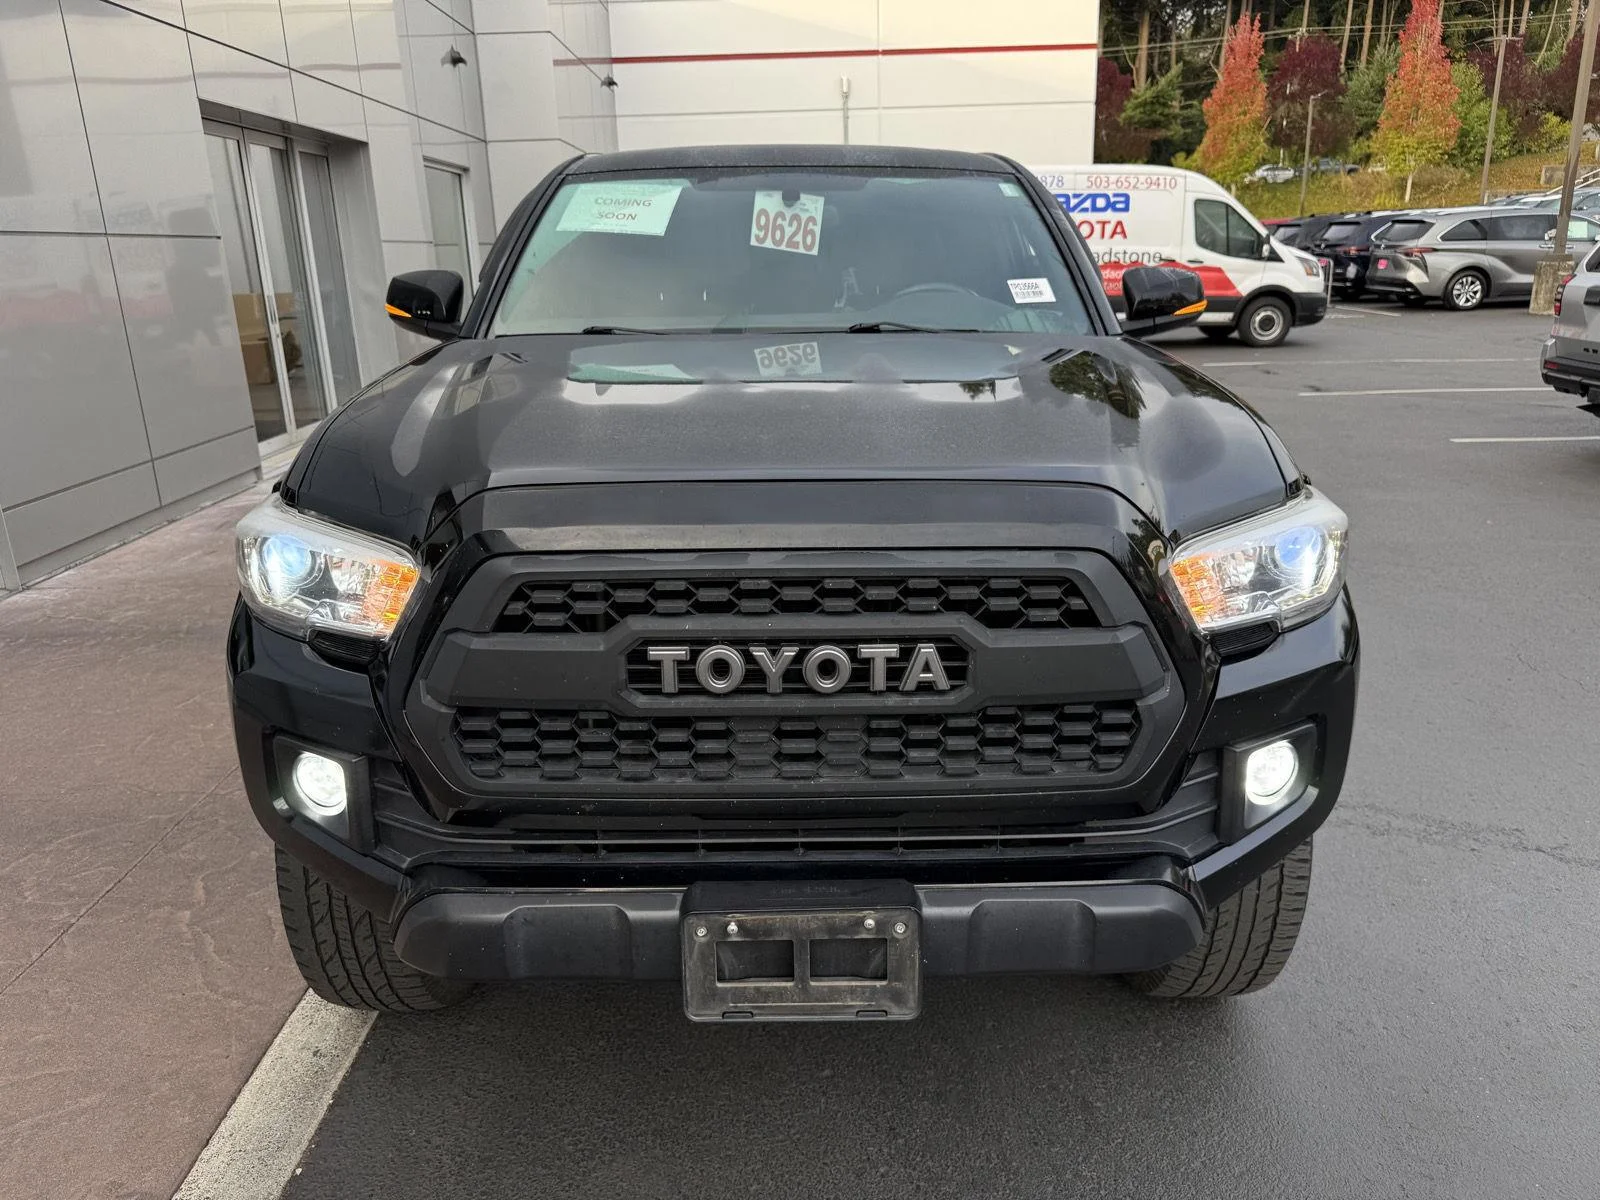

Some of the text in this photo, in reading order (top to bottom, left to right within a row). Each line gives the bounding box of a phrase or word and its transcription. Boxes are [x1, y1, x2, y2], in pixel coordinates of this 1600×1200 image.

[1040, 175, 1177, 190] 878 503-652-9410
[594, 197, 653, 208] COMING
[597, 211, 638, 221] SOON
[755, 208, 817, 252] 9626
[1078, 220, 1128, 239] OTA
[1095, 248, 1162, 263] adstone
[647, 643, 951, 694] TOYOTA
